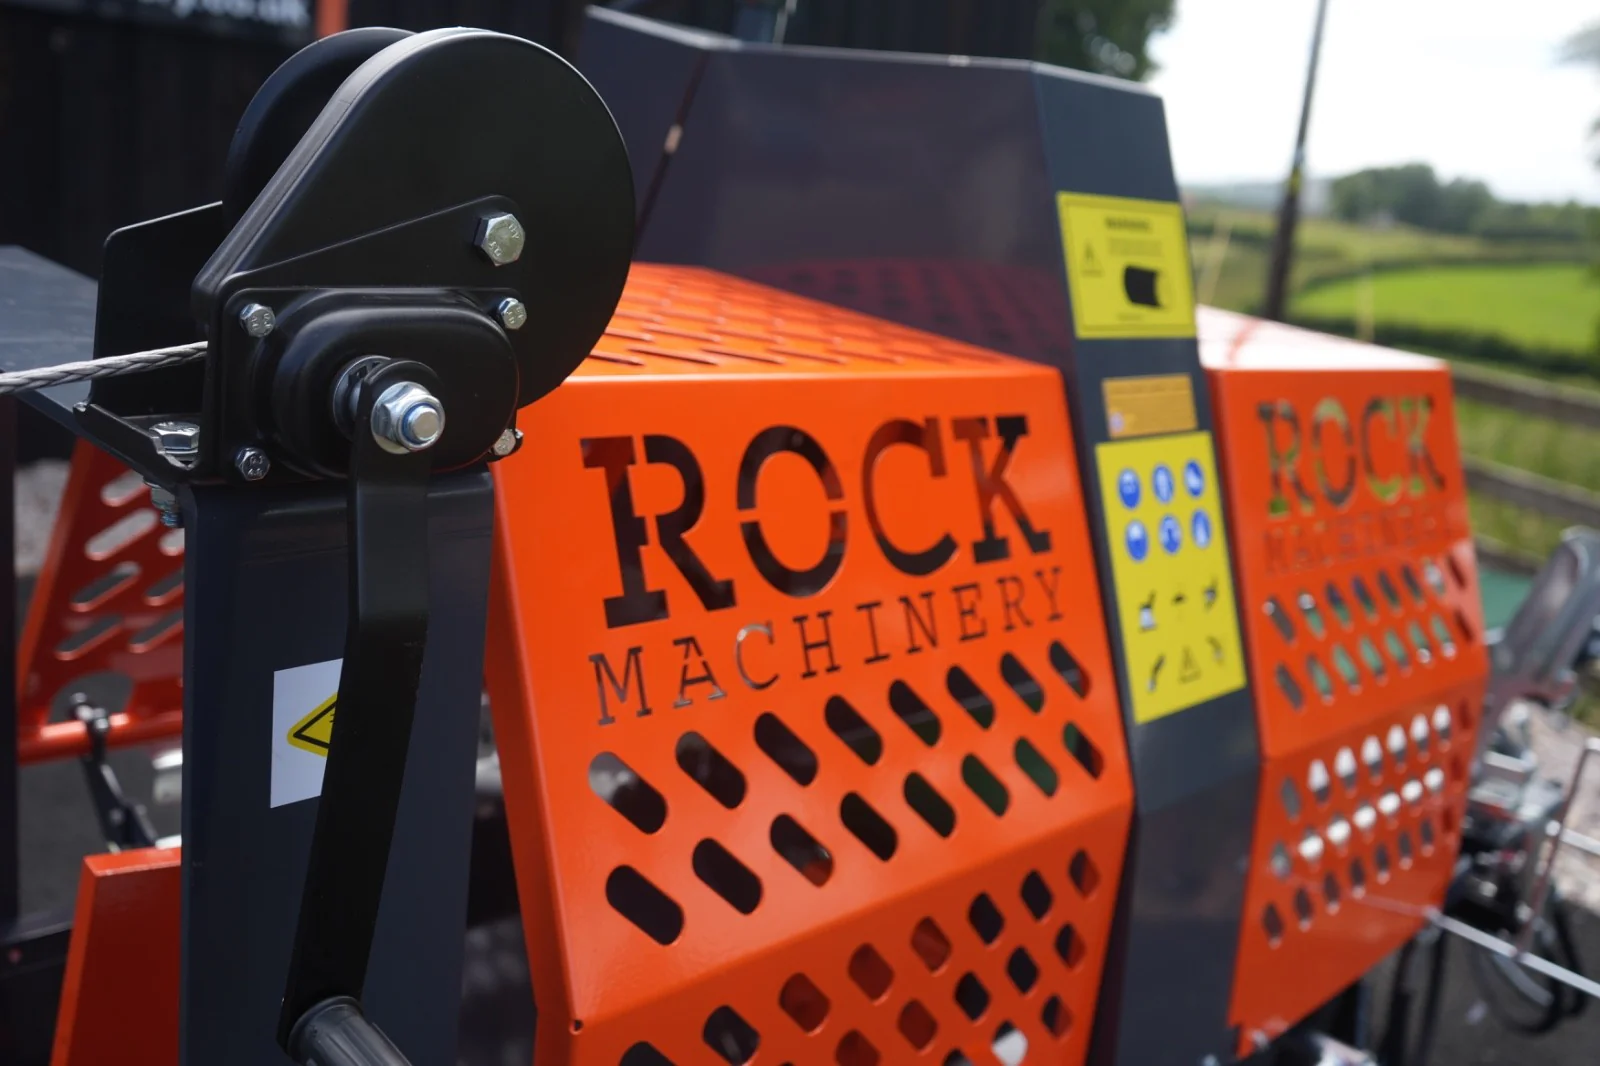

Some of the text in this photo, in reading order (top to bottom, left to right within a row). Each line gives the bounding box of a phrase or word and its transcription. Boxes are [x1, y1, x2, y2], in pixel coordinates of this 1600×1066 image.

[579, 413, 1053, 630] ROCK
[1256, 396, 1446, 517] ROCK
[587, 566, 1064, 726] MACHINERY
